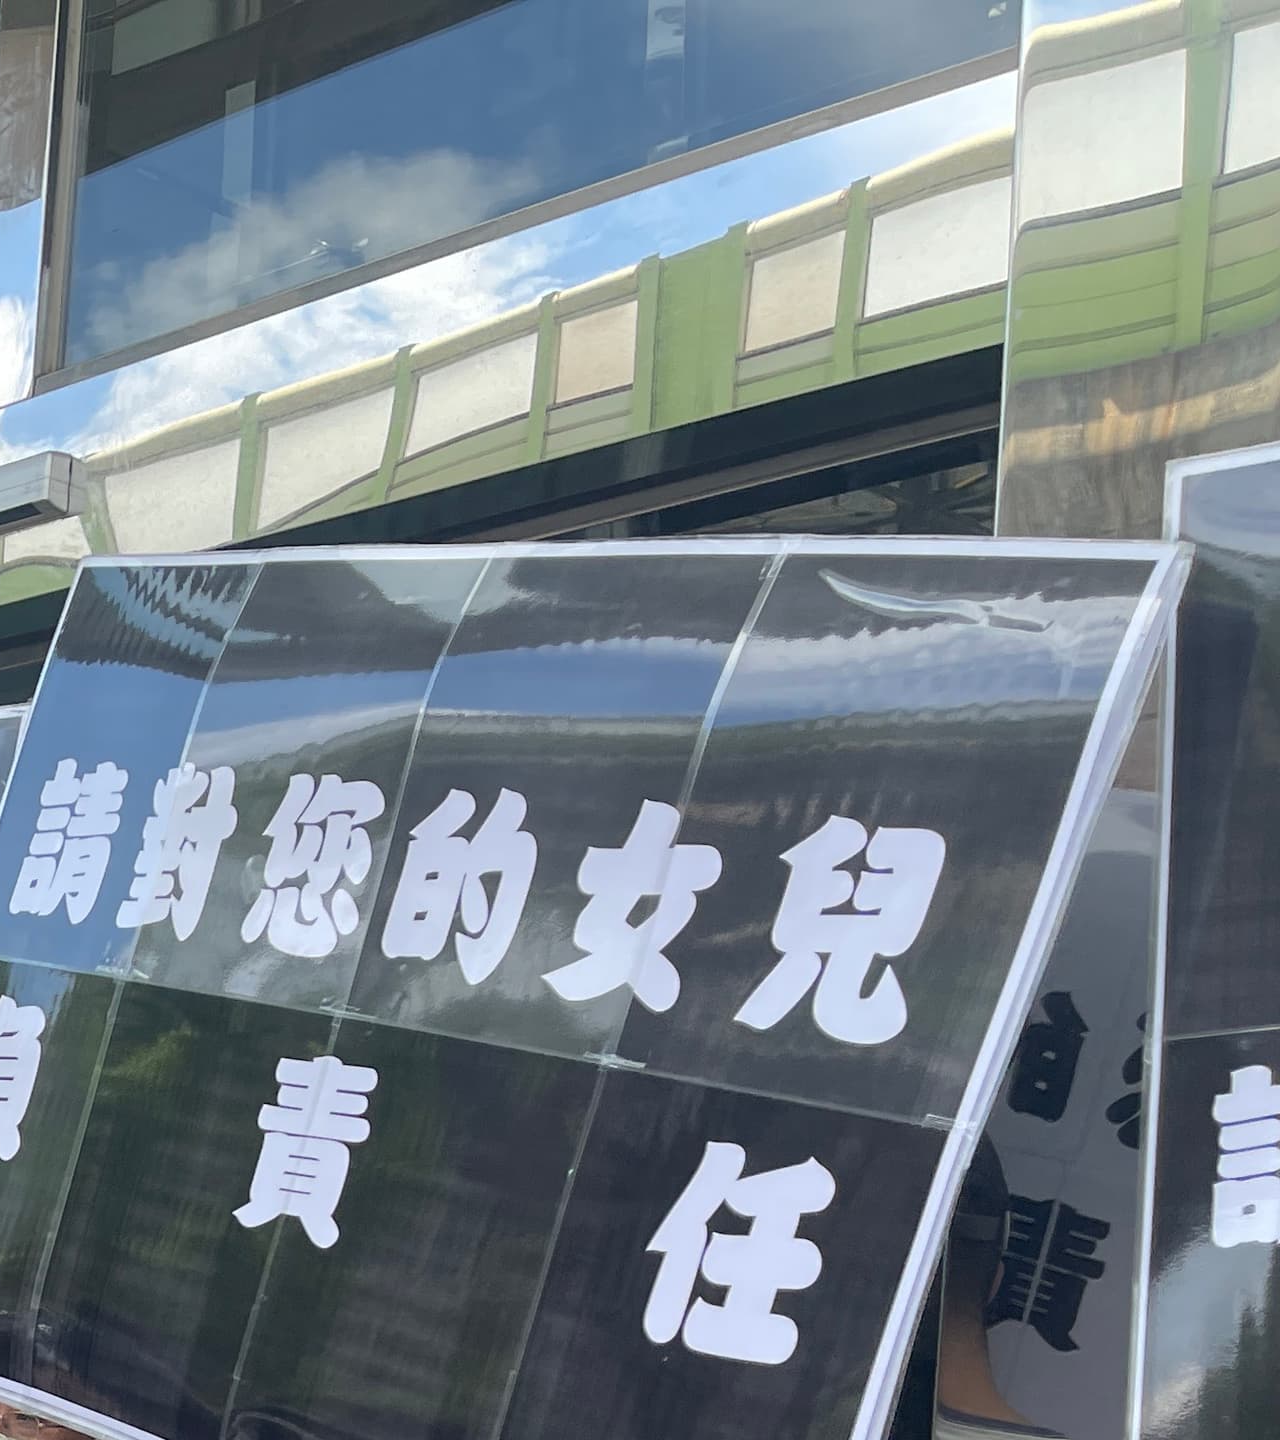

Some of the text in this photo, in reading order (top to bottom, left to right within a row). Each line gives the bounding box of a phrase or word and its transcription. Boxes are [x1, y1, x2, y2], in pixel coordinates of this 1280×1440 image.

[9, 758, 946, 1045] 請對您的女兒
